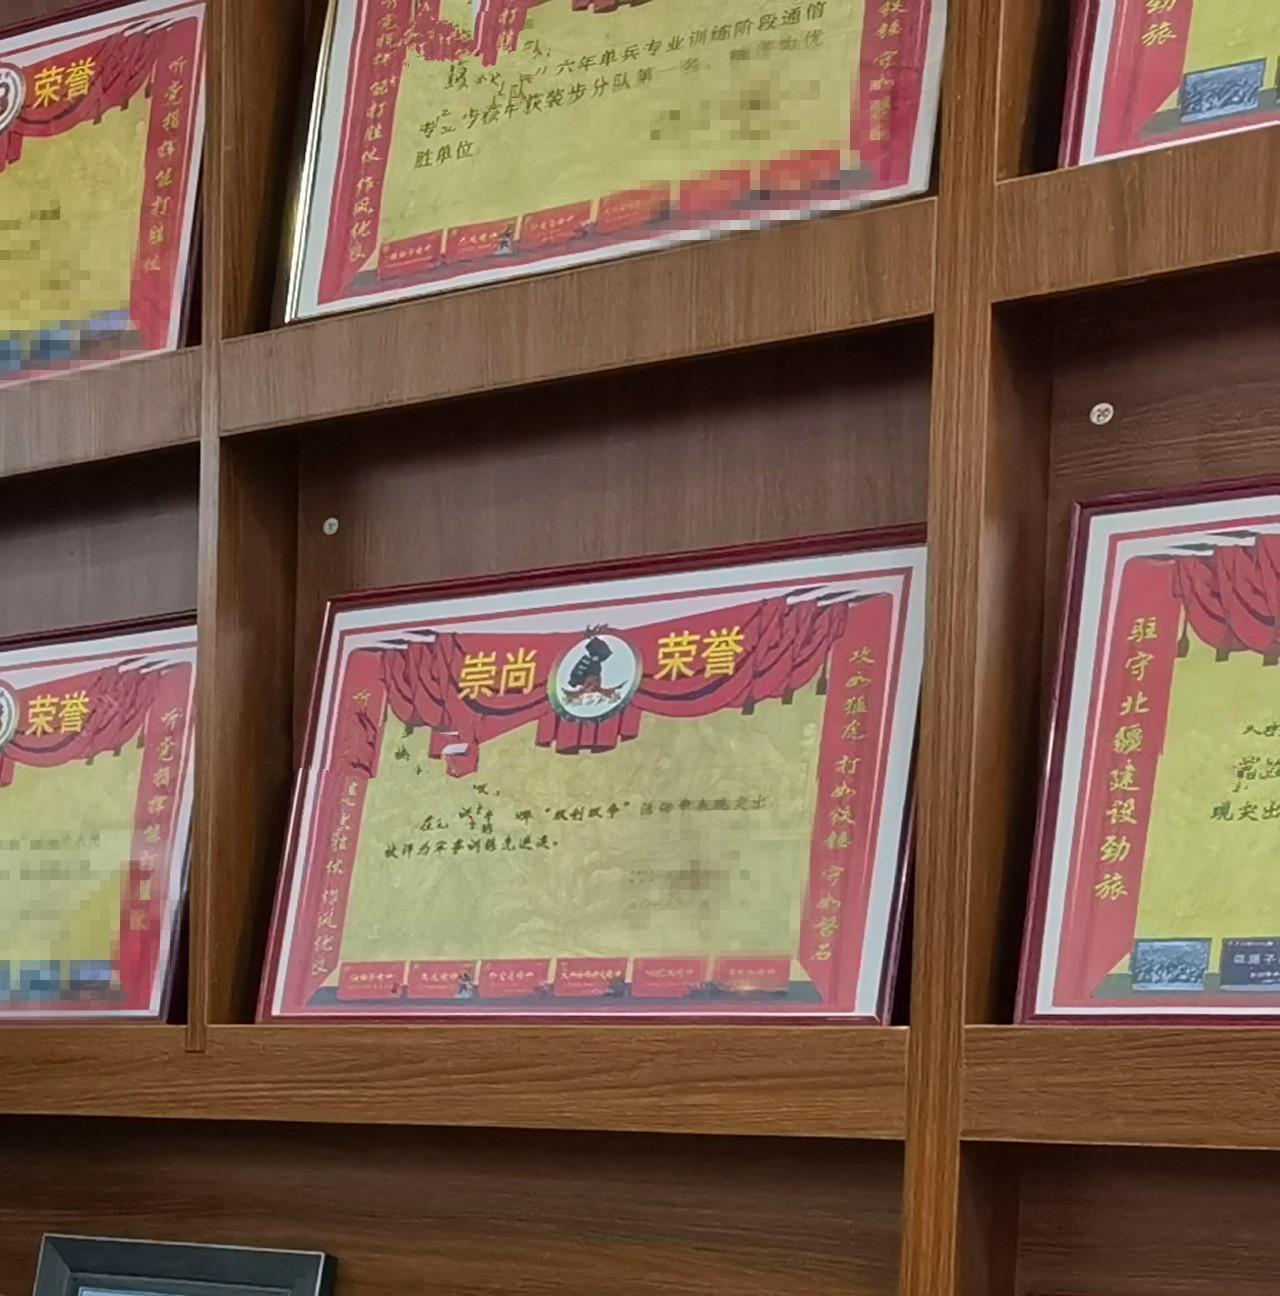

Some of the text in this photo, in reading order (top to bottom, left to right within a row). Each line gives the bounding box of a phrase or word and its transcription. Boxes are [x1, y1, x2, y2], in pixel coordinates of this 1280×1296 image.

[32, 56, 97, 109] 荣誉
[457, 624, 746, 701] 崇尚 荣誉
[24, 691, 90, 737] 荣誉
[1094, 616, 1159, 900] 驻守北疆建设劲旅
